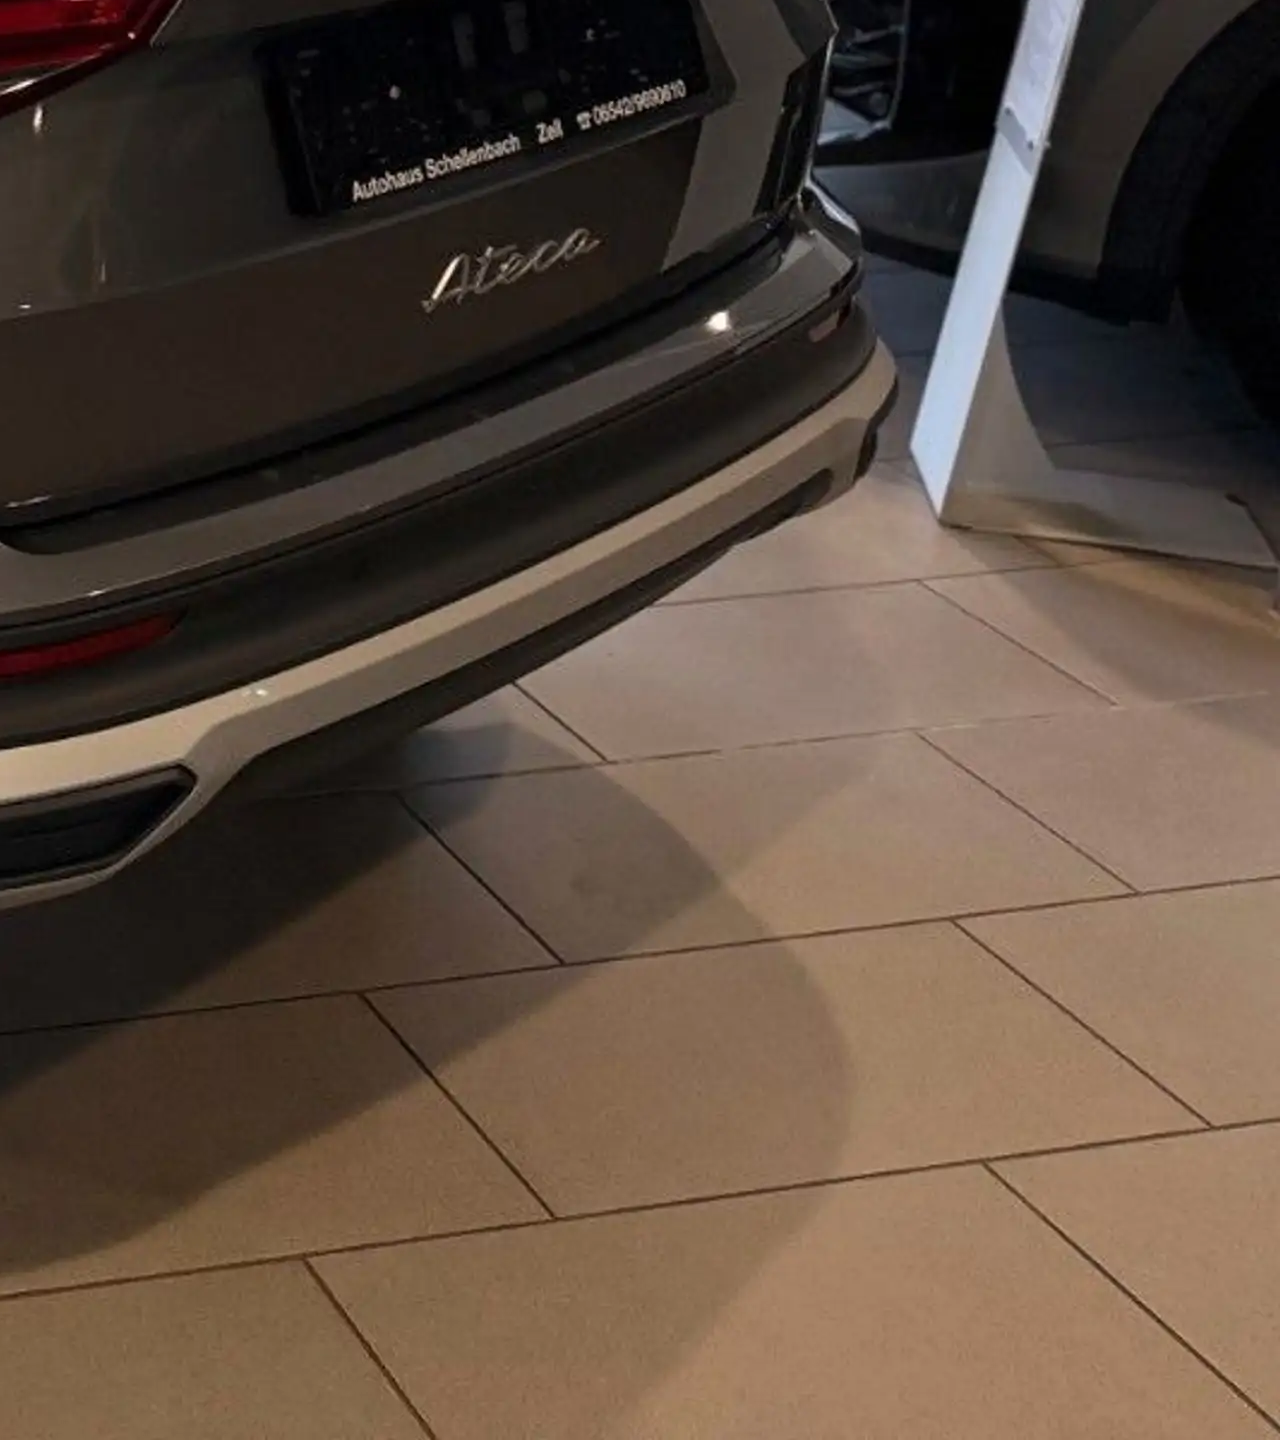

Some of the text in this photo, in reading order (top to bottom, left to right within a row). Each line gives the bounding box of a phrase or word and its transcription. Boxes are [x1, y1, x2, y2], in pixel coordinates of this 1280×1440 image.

[351, 165, 424, 203] Autohaus
[424, 132, 522, 180] Schellenbach
[535, 117, 564, 145] Zell
[420, 227, 601, 314] Ateca
